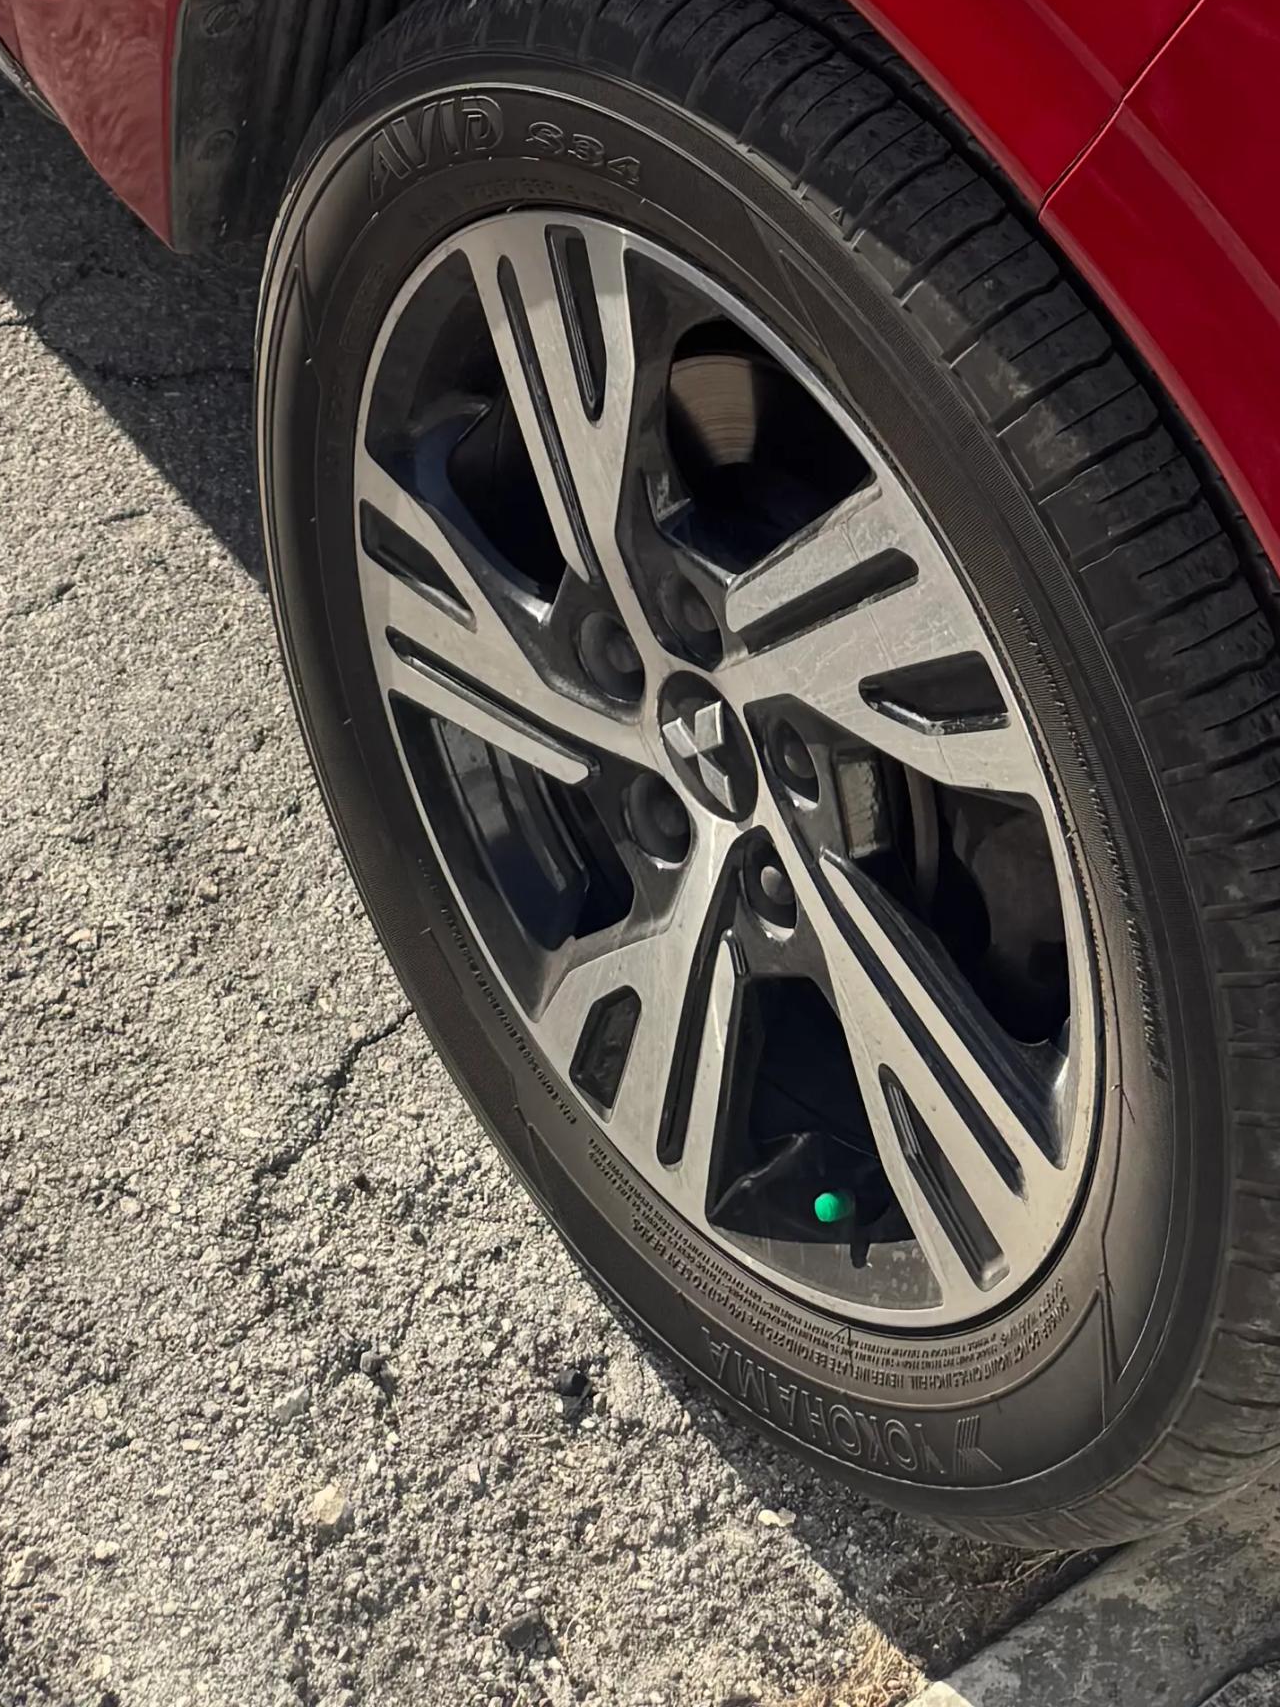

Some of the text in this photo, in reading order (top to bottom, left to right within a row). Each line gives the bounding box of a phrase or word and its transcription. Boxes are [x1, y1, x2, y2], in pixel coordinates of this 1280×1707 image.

[367, 96, 642, 201] AVID S34
[704, 1328, 945, 1475] YOKOHAMA
